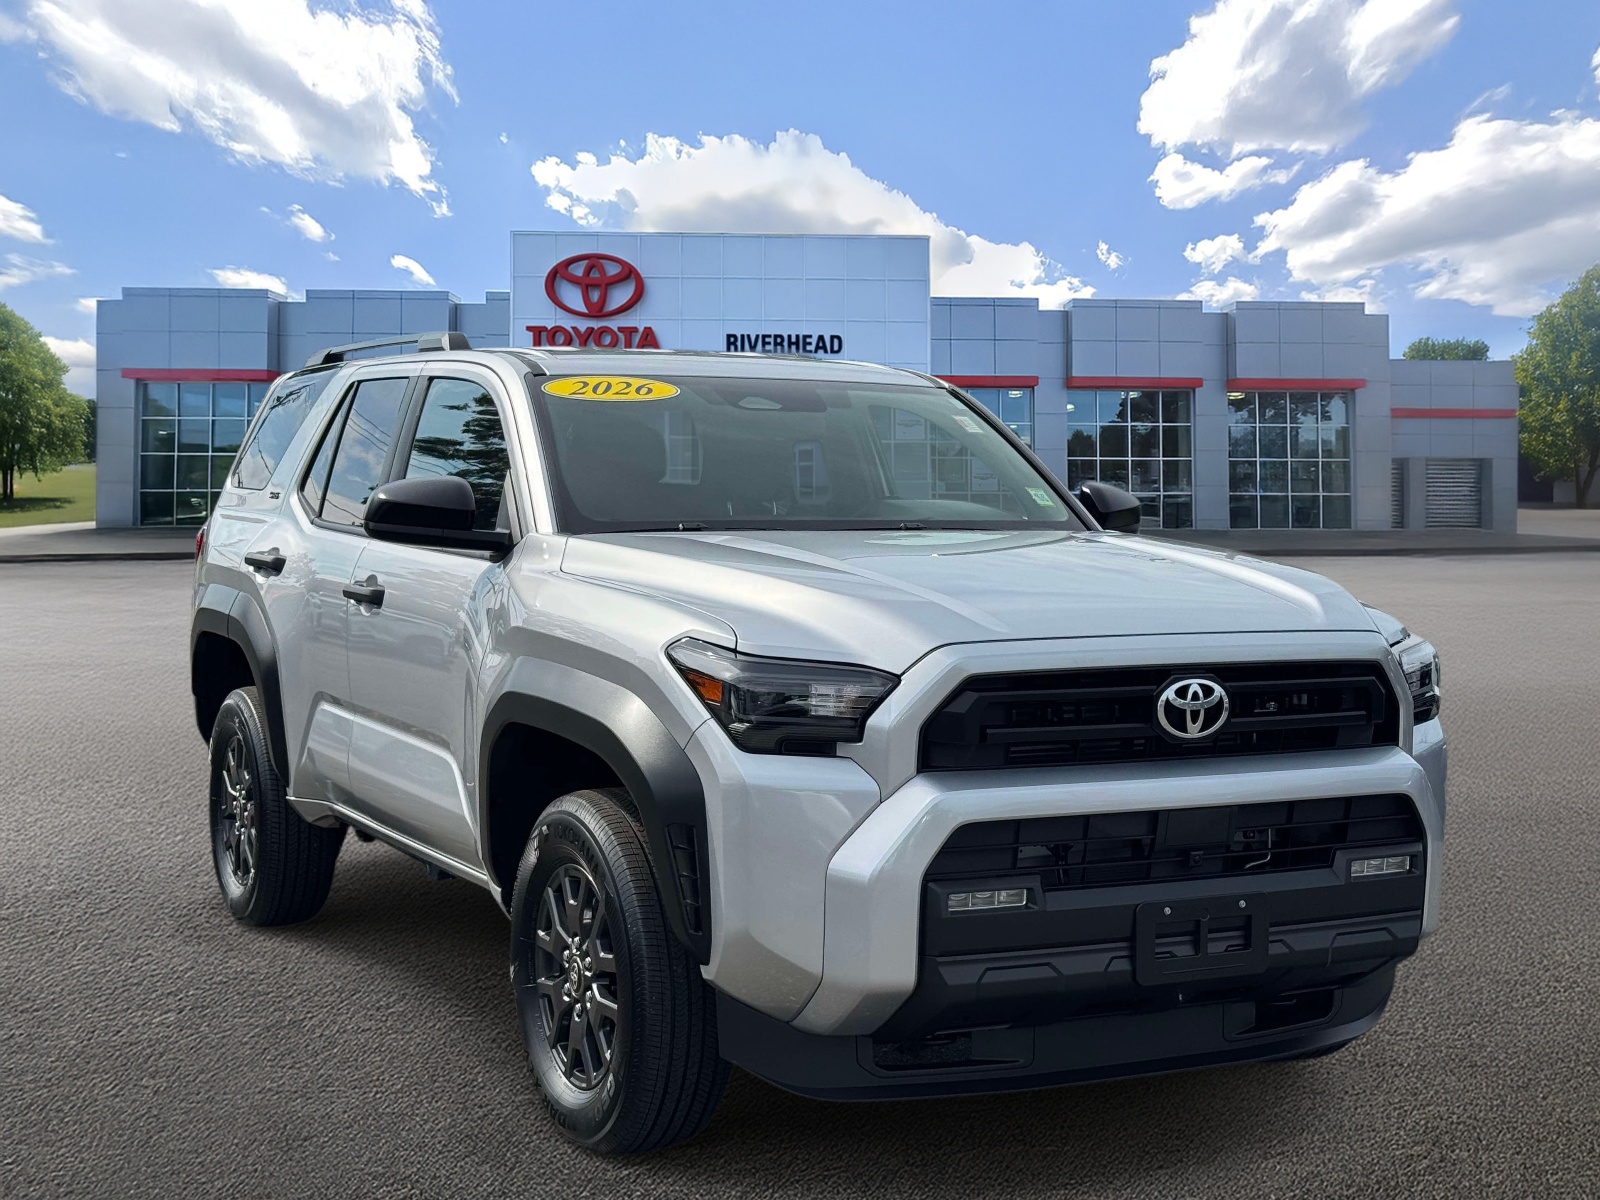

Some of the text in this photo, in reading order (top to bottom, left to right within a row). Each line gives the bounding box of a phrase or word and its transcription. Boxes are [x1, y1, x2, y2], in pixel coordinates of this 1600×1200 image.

[526, 325, 660, 348] TOYOTA
[726, 333, 843, 354] RIVERHEAD
[568, 381, 656, 395] 2026
